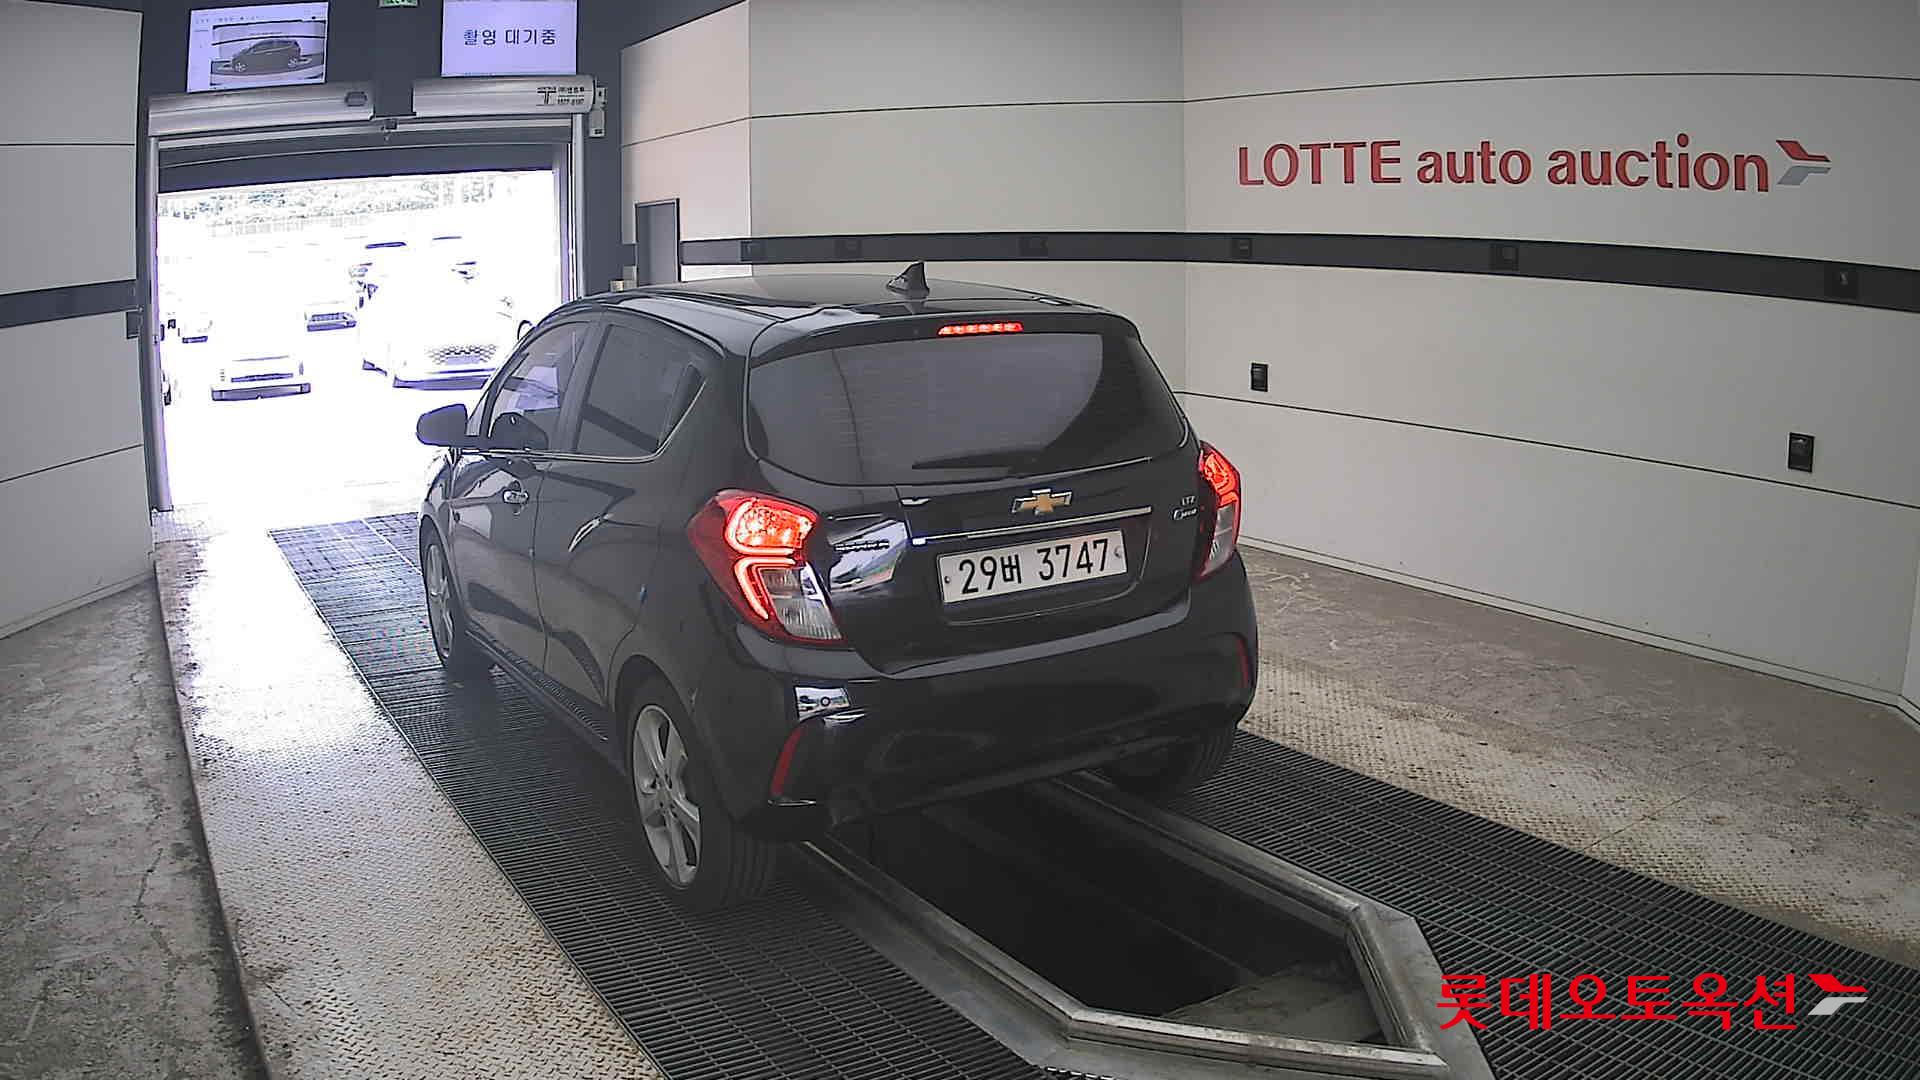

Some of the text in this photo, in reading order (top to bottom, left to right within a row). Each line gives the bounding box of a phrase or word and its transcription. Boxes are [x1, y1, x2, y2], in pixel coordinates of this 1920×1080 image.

[464, 29, 556, 46] 촬영 대기중
[1238, 133, 1770, 193] LOTTE auto auction
[959, 538, 1109, 595] 29버 3747
